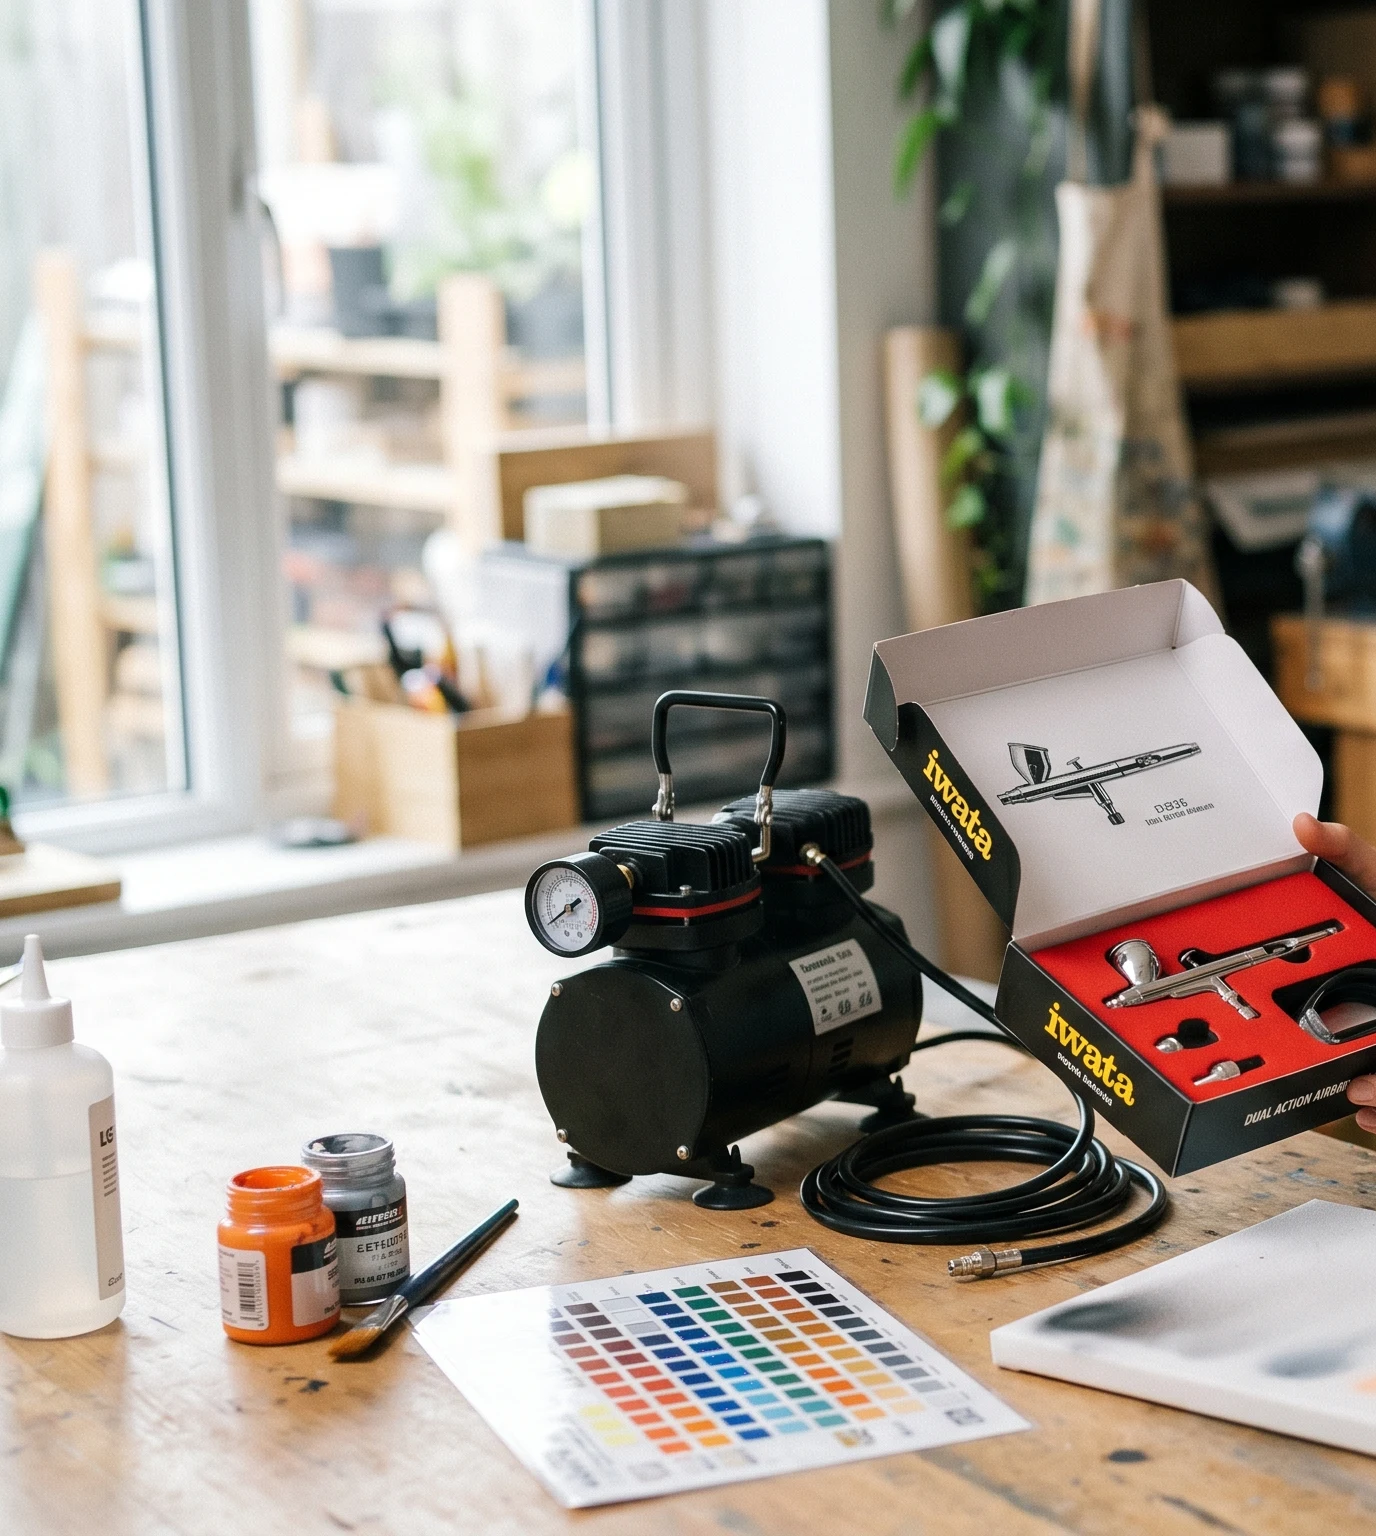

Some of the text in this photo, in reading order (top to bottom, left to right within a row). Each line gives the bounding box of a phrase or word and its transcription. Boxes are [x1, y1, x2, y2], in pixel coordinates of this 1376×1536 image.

[922, 749, 992, 861] iwata
[1044, 1001, 1135, 1106] iwata
[1244, 1107, 1272, 1127] DUAL
[1273, 1092, 1313, 1116] ACTION
